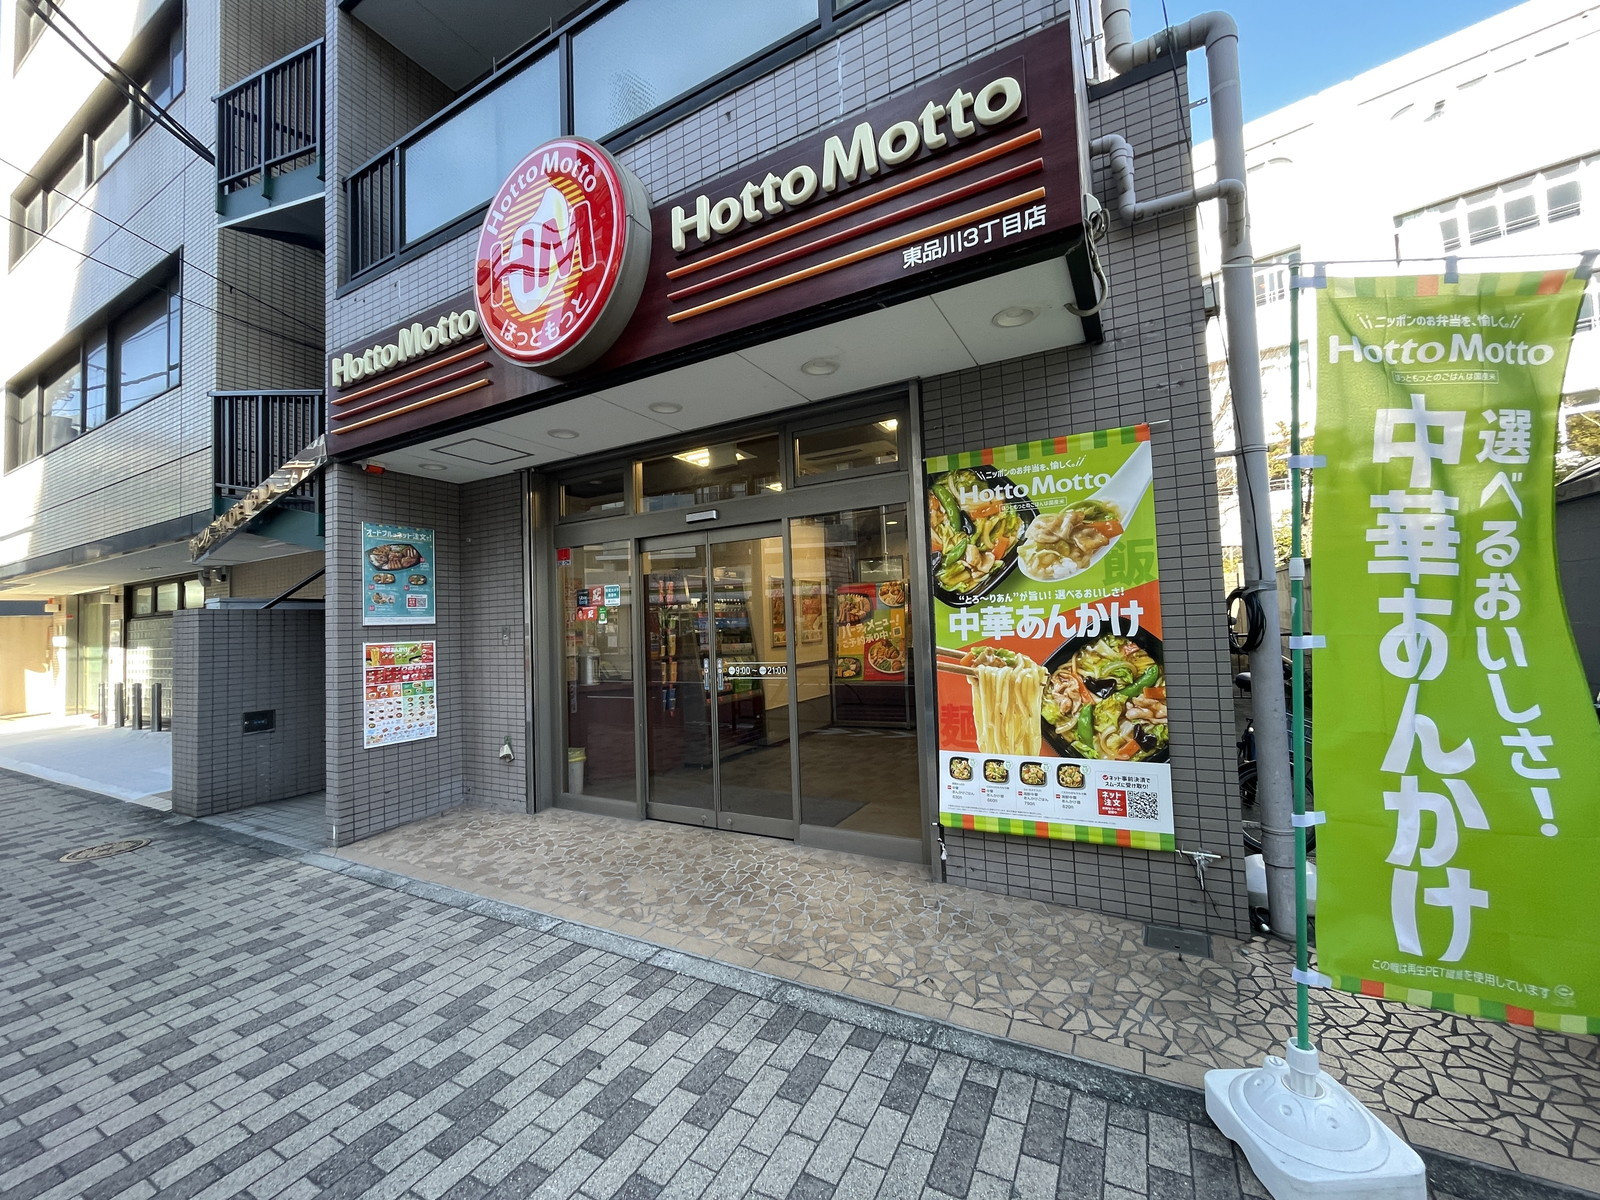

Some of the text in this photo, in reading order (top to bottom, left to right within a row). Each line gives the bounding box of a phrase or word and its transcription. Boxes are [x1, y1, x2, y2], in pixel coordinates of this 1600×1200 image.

[671, 76, 1022, 253] Hotto Motto
[486, 150, 597, 236] Hotto Motto
[902, 204, 1048, 269] 東品川3丁目店
[500, 292, 590, 347] ほっともっと
[1375, 314, 1510, 328] ニッポンのお弁当を、愉しく。
[332, 344, 398, 388] Hotto
[1329, 333, 1555, 366] Hotto Motto
[959, 472, 1111, 505] Hotto Motto
[1103, 538, 1155, 586] 飯
[949, 600, 1144, 642] 中華あんかけ
[735, 666, 751, 675] 9:00
[767, 666, 787, 675] 21:00
[1366, 393, 1491, 963] 中華あんかけ
[1101, 791, 1121, 799] ネット
[1103, 799, 1121, 807] 注文
